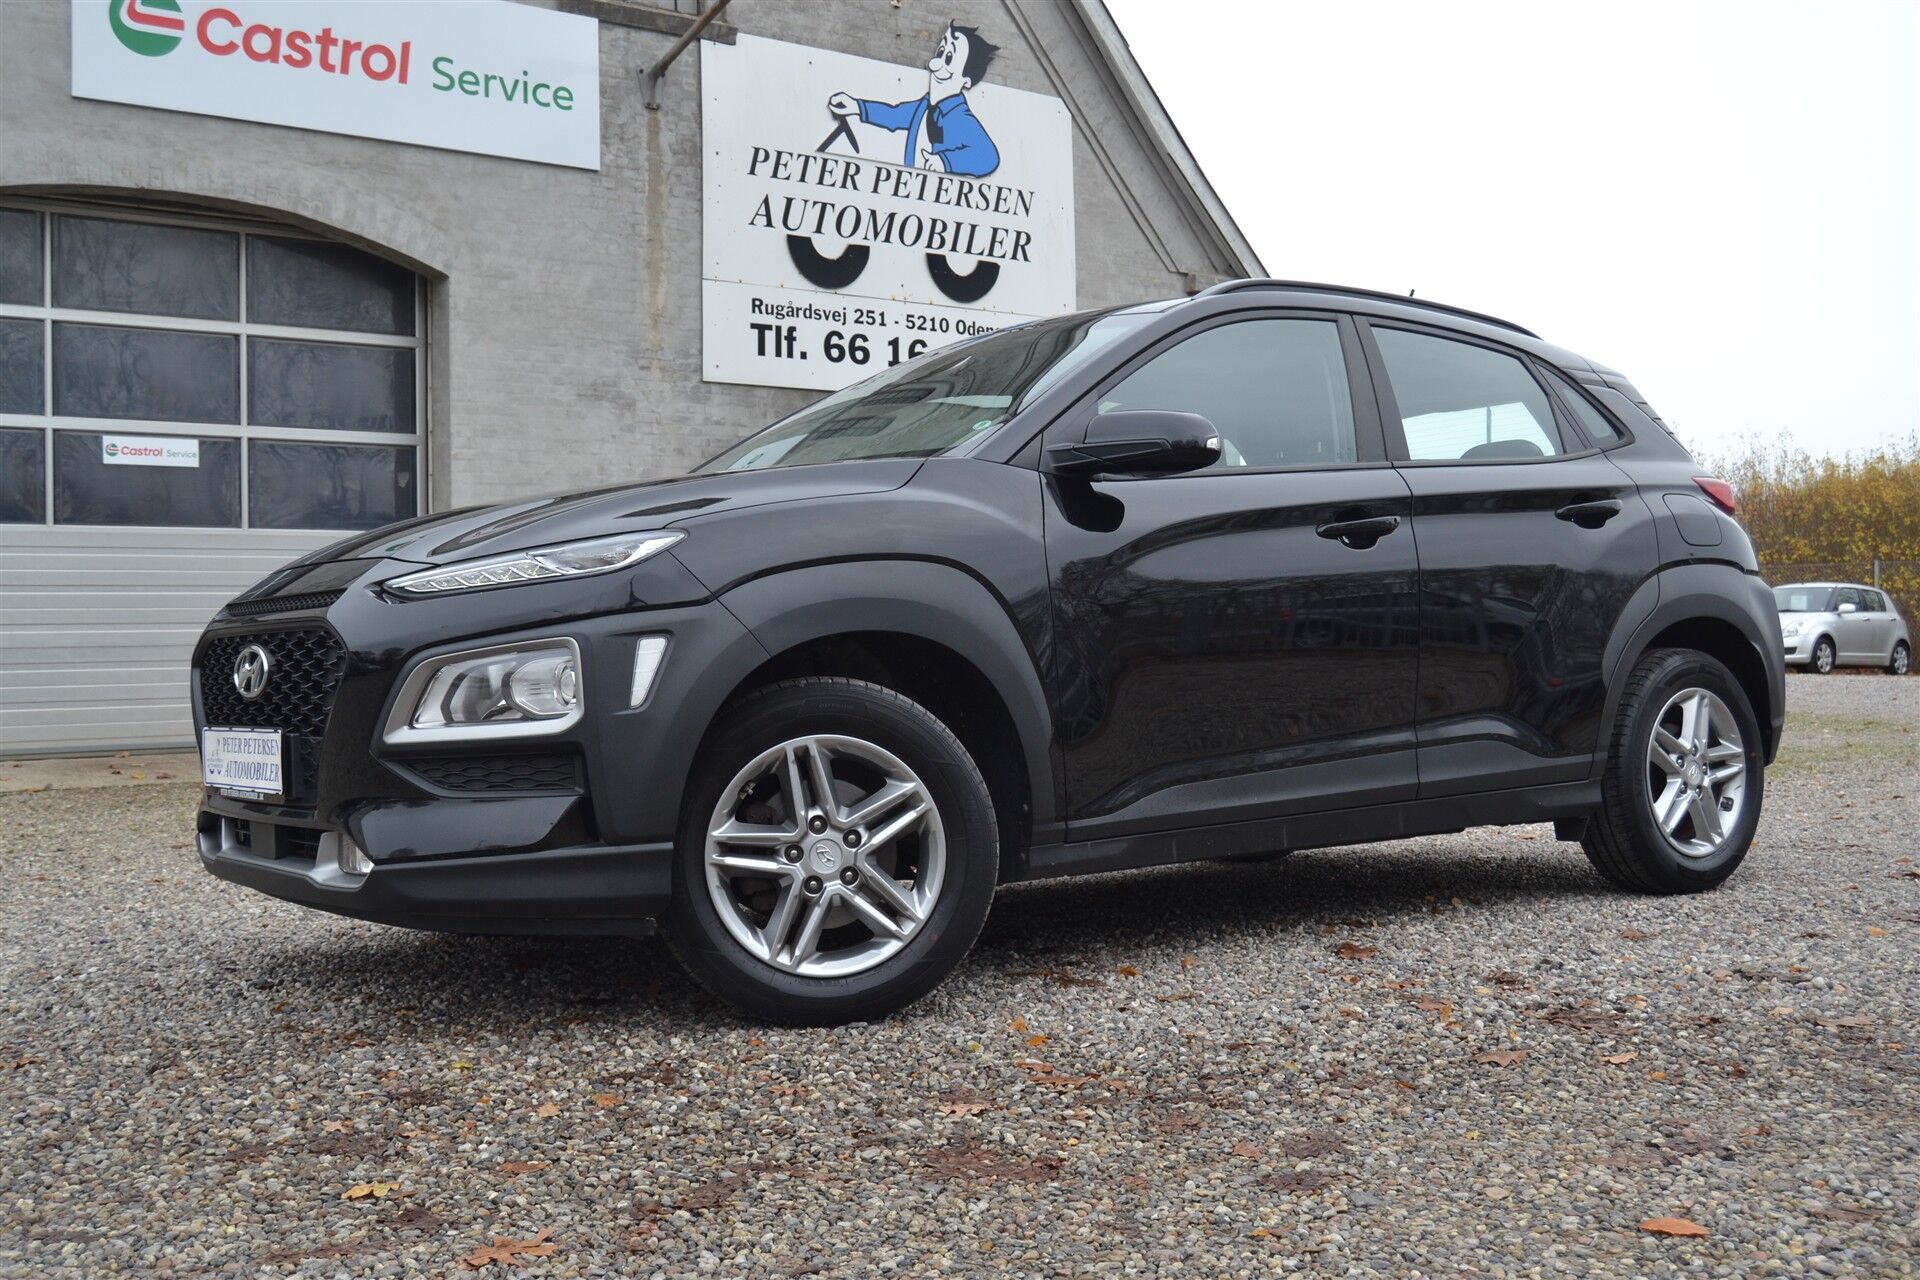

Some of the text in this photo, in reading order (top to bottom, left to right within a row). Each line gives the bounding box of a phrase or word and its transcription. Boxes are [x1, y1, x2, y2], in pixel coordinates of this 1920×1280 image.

[196, 8, 574, 111] Castrol Service
[746, 145, 1036, 218] PETER PETERSEN
[748, 192, 1033, 263] AUTOMOBILER
[751, 297, 847, 326] Rugårdsvej
[853, 308, 887, 327] 251
[905, 314, 949, 333] 5210
[750, 322, 808, 361] Tlf.
[823, 330, 871, 366] 66
[121, 446, 198, 459] Castrol Service
[222, 737, 280, 756] PETER PETERSEN
[224, 760, 280, 783] AUTOMOBILER
